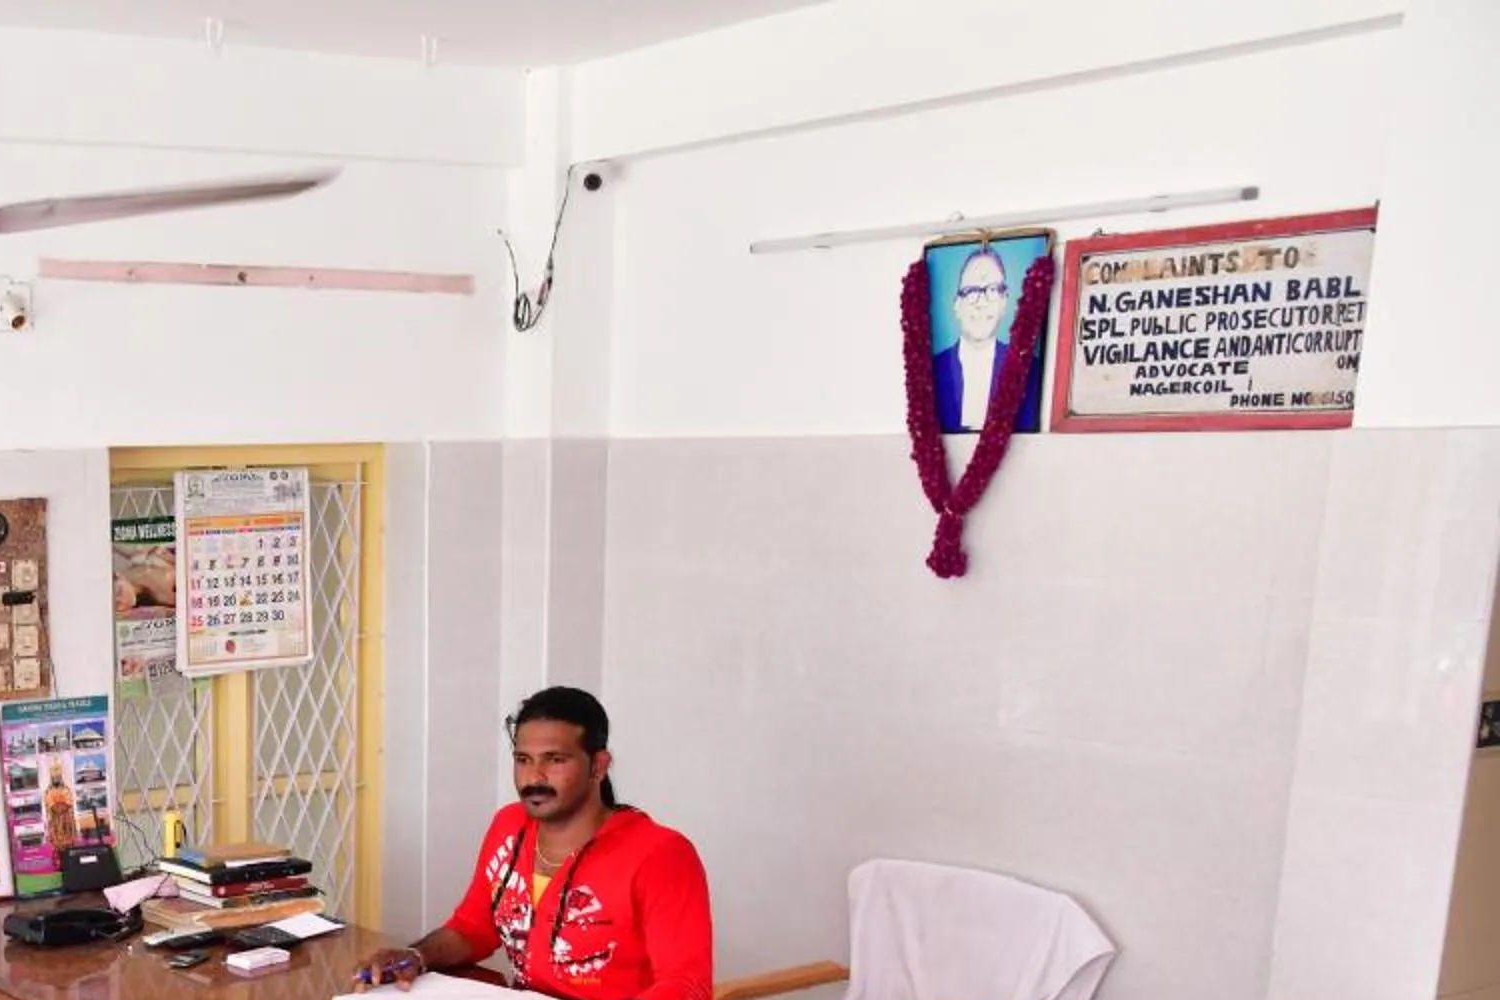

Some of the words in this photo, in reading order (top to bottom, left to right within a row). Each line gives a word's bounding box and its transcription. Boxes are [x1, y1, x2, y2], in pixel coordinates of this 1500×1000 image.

[1257, 246, 1299, 272] TO
[1084, 338, 1210, 366] VIGILANCE
[1135, 361, 1248, 379] ADVOCATE
[1129, 380, 1233, 396] NAGERCOIL
[1230, 393, 1284, 407] PHONE
[223, 613, 236, 625] 27
[271, 610, 285, 621] 30
